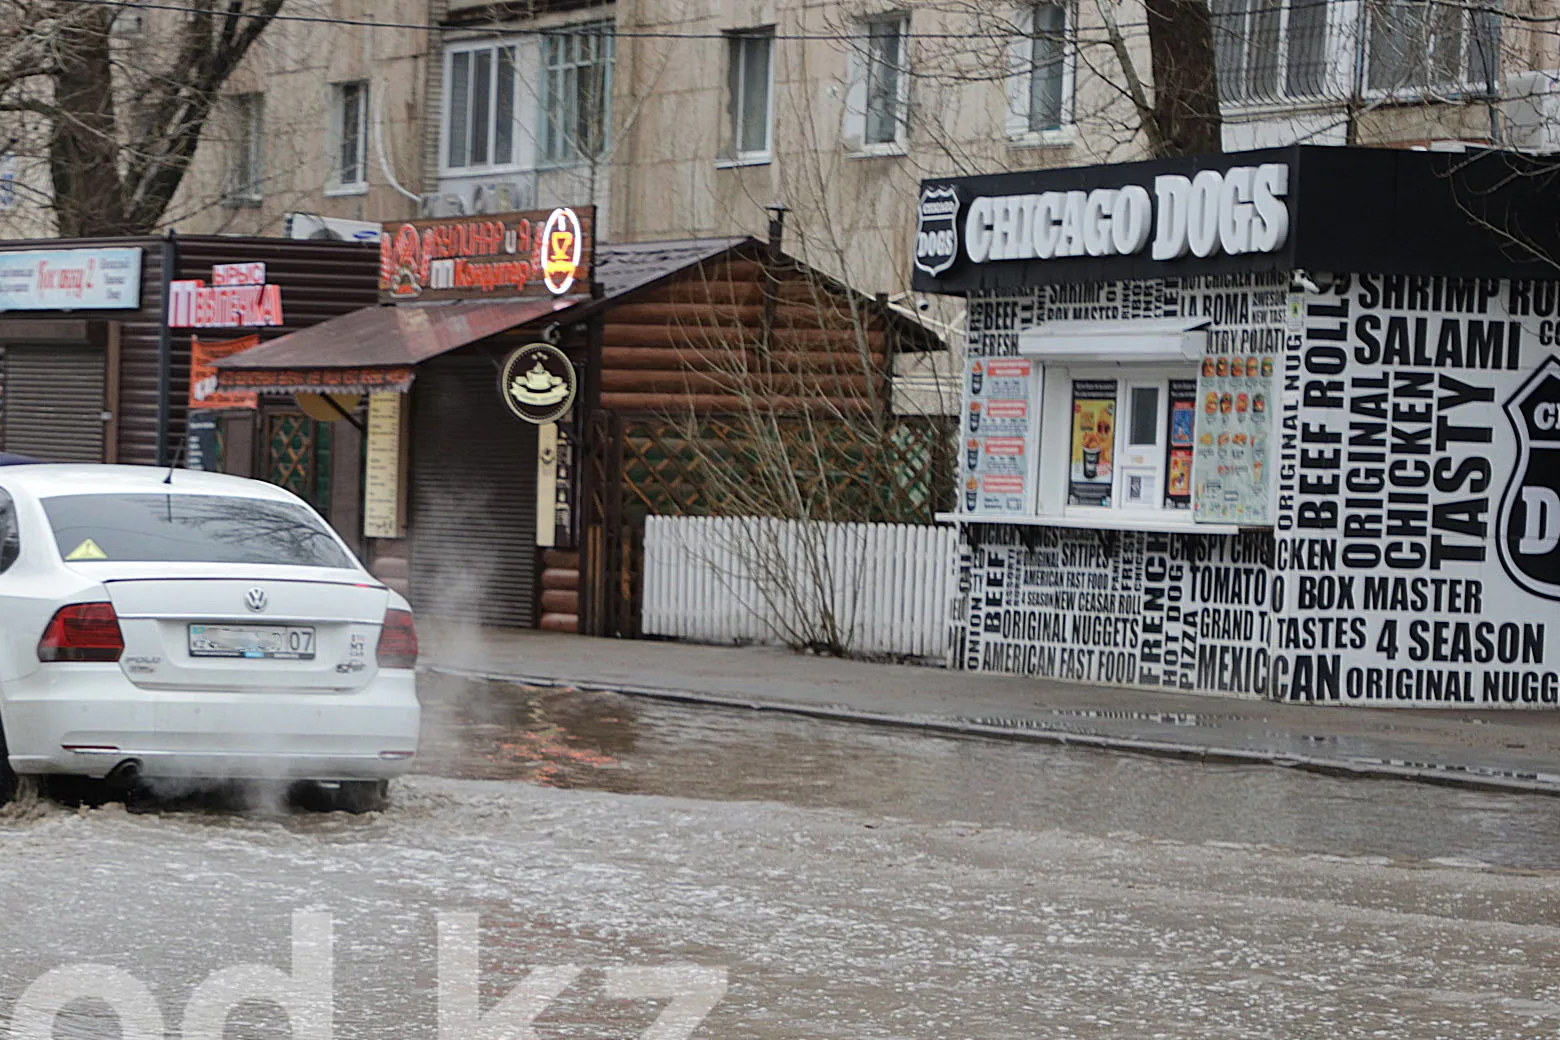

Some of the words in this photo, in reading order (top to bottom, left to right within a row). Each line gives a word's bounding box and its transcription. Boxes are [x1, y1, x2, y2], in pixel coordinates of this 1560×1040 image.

[965, 185, 1152, 263] CHICAGO
[1152, 163, 1289, 261] DOGS
[917, 229, 953, 258] DOGS
[1358, 274, 1500, 314] SHRIMP
[1509, 278, 1560, 317] RO
[1354, 314, 1522, 370] SALAMI
[1278, 400, 1299, 531] ORIGINAL
[1297, 422, 1343, 529] BEEF
[1342, 371, 1390, 569] ORIGINAL
[1384, 371, 1435, 570] CHICKEN
[1429, 372, 1496, 570] TASTY
[1169, 532, 1227, 563] CRSPY
[1277, 538, 1337, 571] CKEN
[984, 551, 1006, 633] BEEF
[1024, 569, 1064, 588] AMERICAN
[1067, 572, 1086, 589] FAST
[1088, 573, 1109, 590] FOOD
[1054, 590, 1077, 611] NEW
[1078, 592, 1116, 614] CEASAR
[1119, 594, 1141, 616] ROLL
[1166, 564, 1184, 622] DOG
[1190, 565, 1267, 606] TOMATO
[1298, 575, 1355, 610] BOX
[1363, 576, 1483, 614] MASTER
[1002, 609, 1068, 644] ORIGINAL
[1071, 613, 1140, 649] NUGGETS
[1140, 532, 1169, 686] FRENCH
[1200, 607, 1255, 641] GRAND
[289, 631, 313, 651] 07
[967, 597, 983, 671] ONION
[1179, 609, 1198, 691] PIZZA
[1277, 617, 1367, 650] TASTES
[1376, 619, 1399, 661] 4
[1408, 620, 1545, 664] SEASON
[982, 641, 1057, 678] AMERICAN
[1059, 646, 1095, 682] FAST
[1097, 650, 1137, 686] FOOD
[1163, 632, 1180, 687] HOT
[1197, 643, 1269, 696] MEXIC
[1272, 654, 1341, 701] CAN
[1346, 667, 1475, 702] ORIGINAL
[1482, 671, 1560, 705] NUGG
